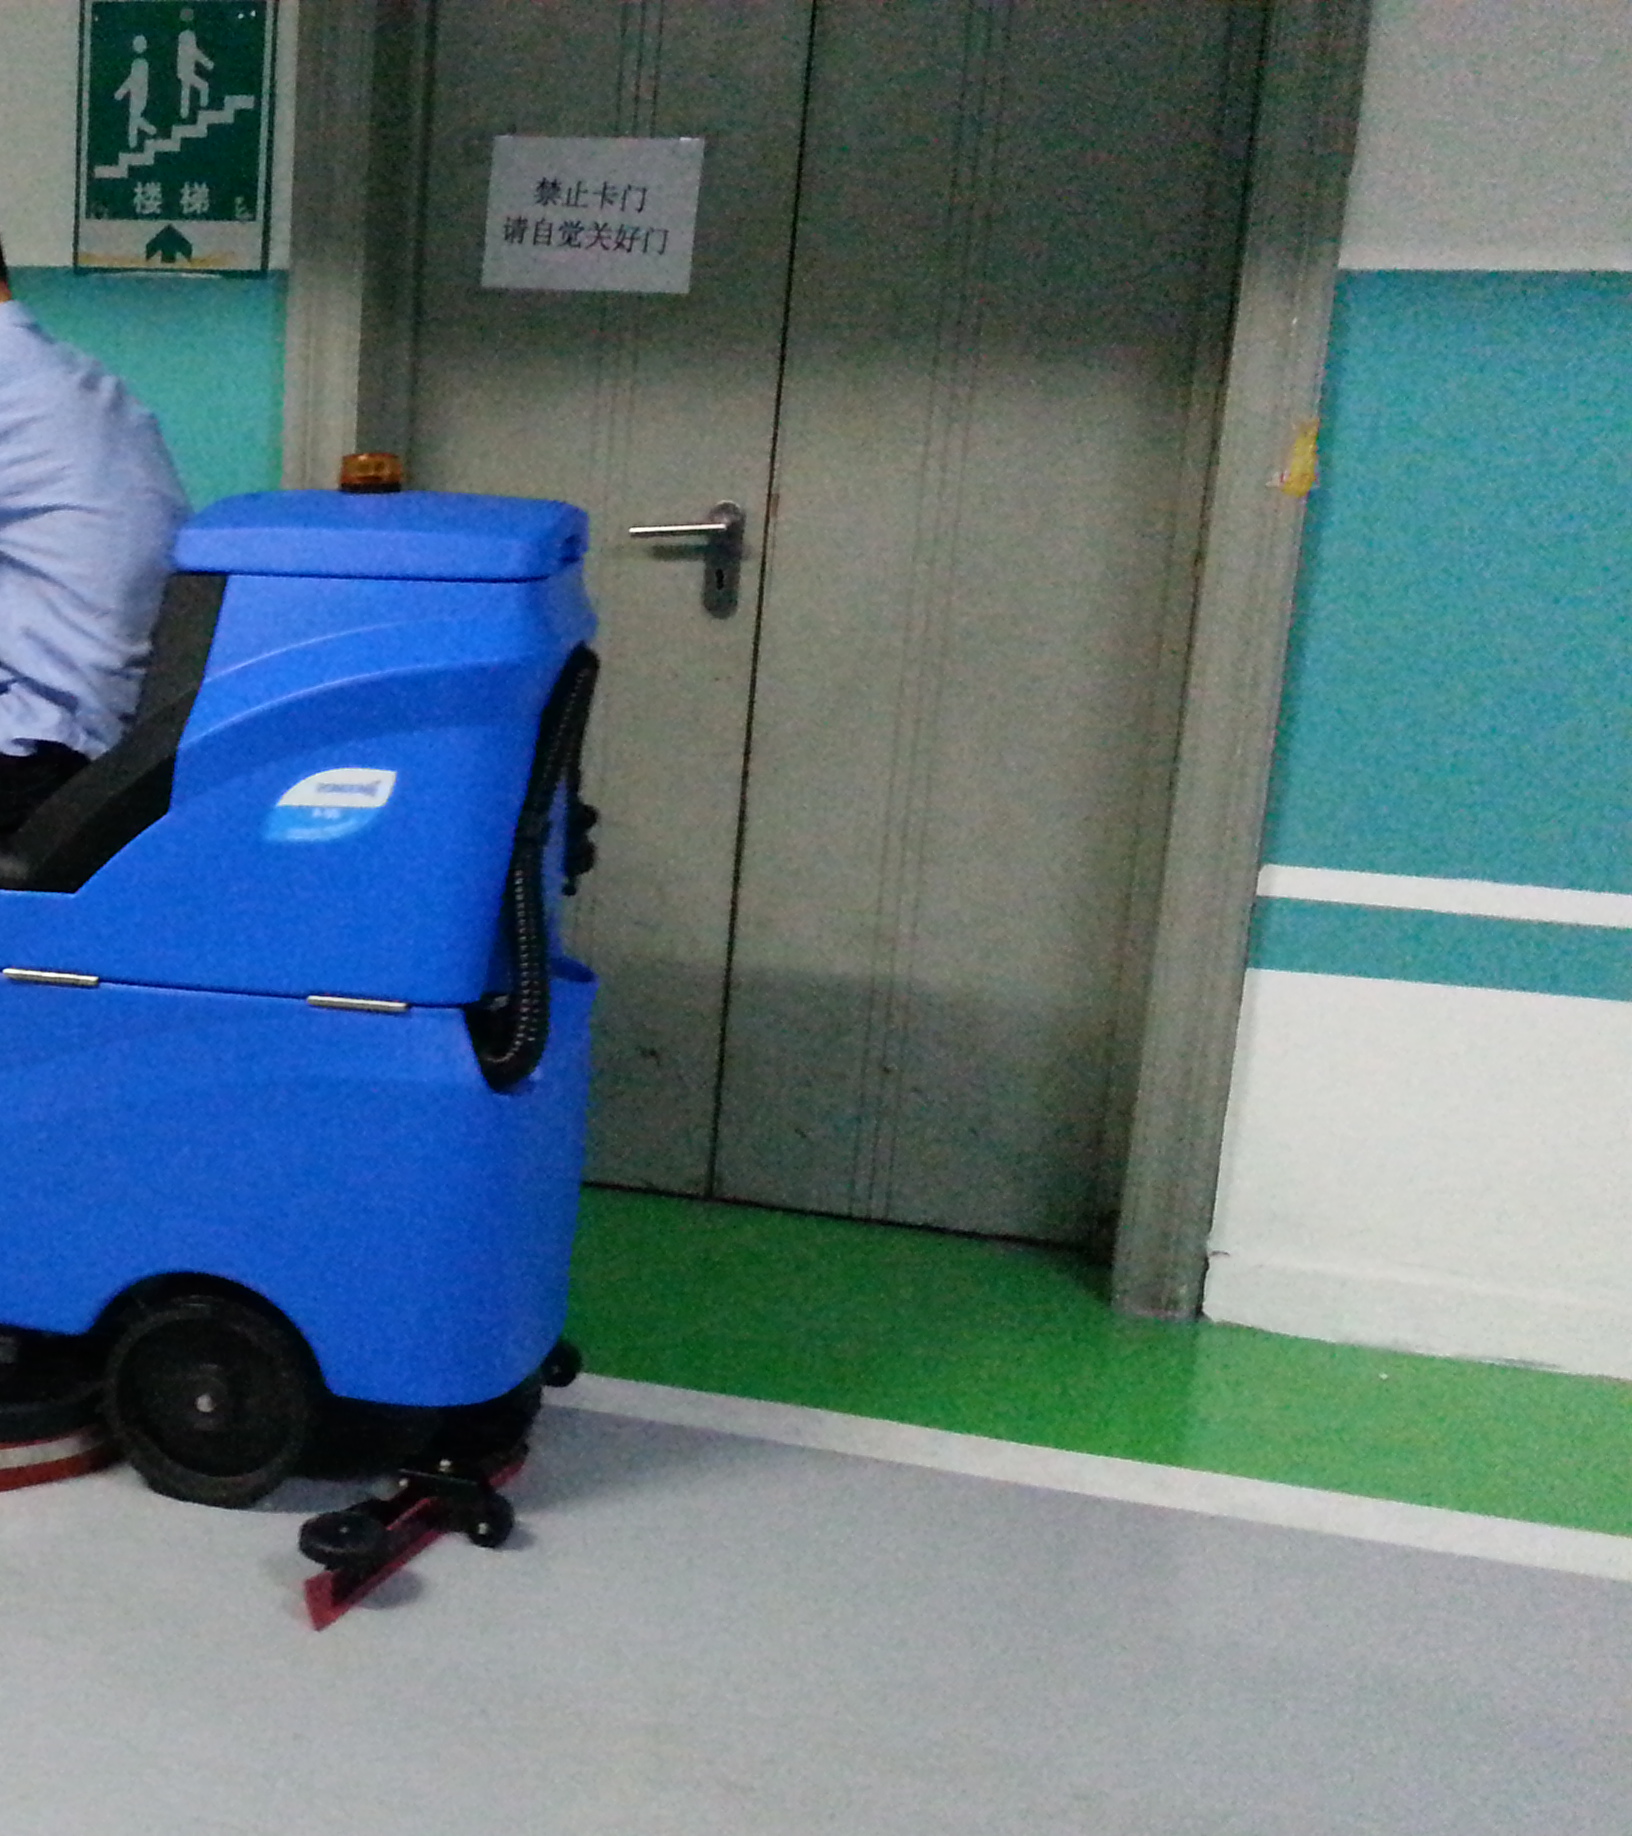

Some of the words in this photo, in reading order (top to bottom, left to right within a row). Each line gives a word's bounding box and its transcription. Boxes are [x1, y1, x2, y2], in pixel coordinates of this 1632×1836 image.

[134, 181, 210, 214] 楼梯
[533, 176, 648, 213] 禁止卡门
[503, 215, 670, 255] 请自觉关好门
